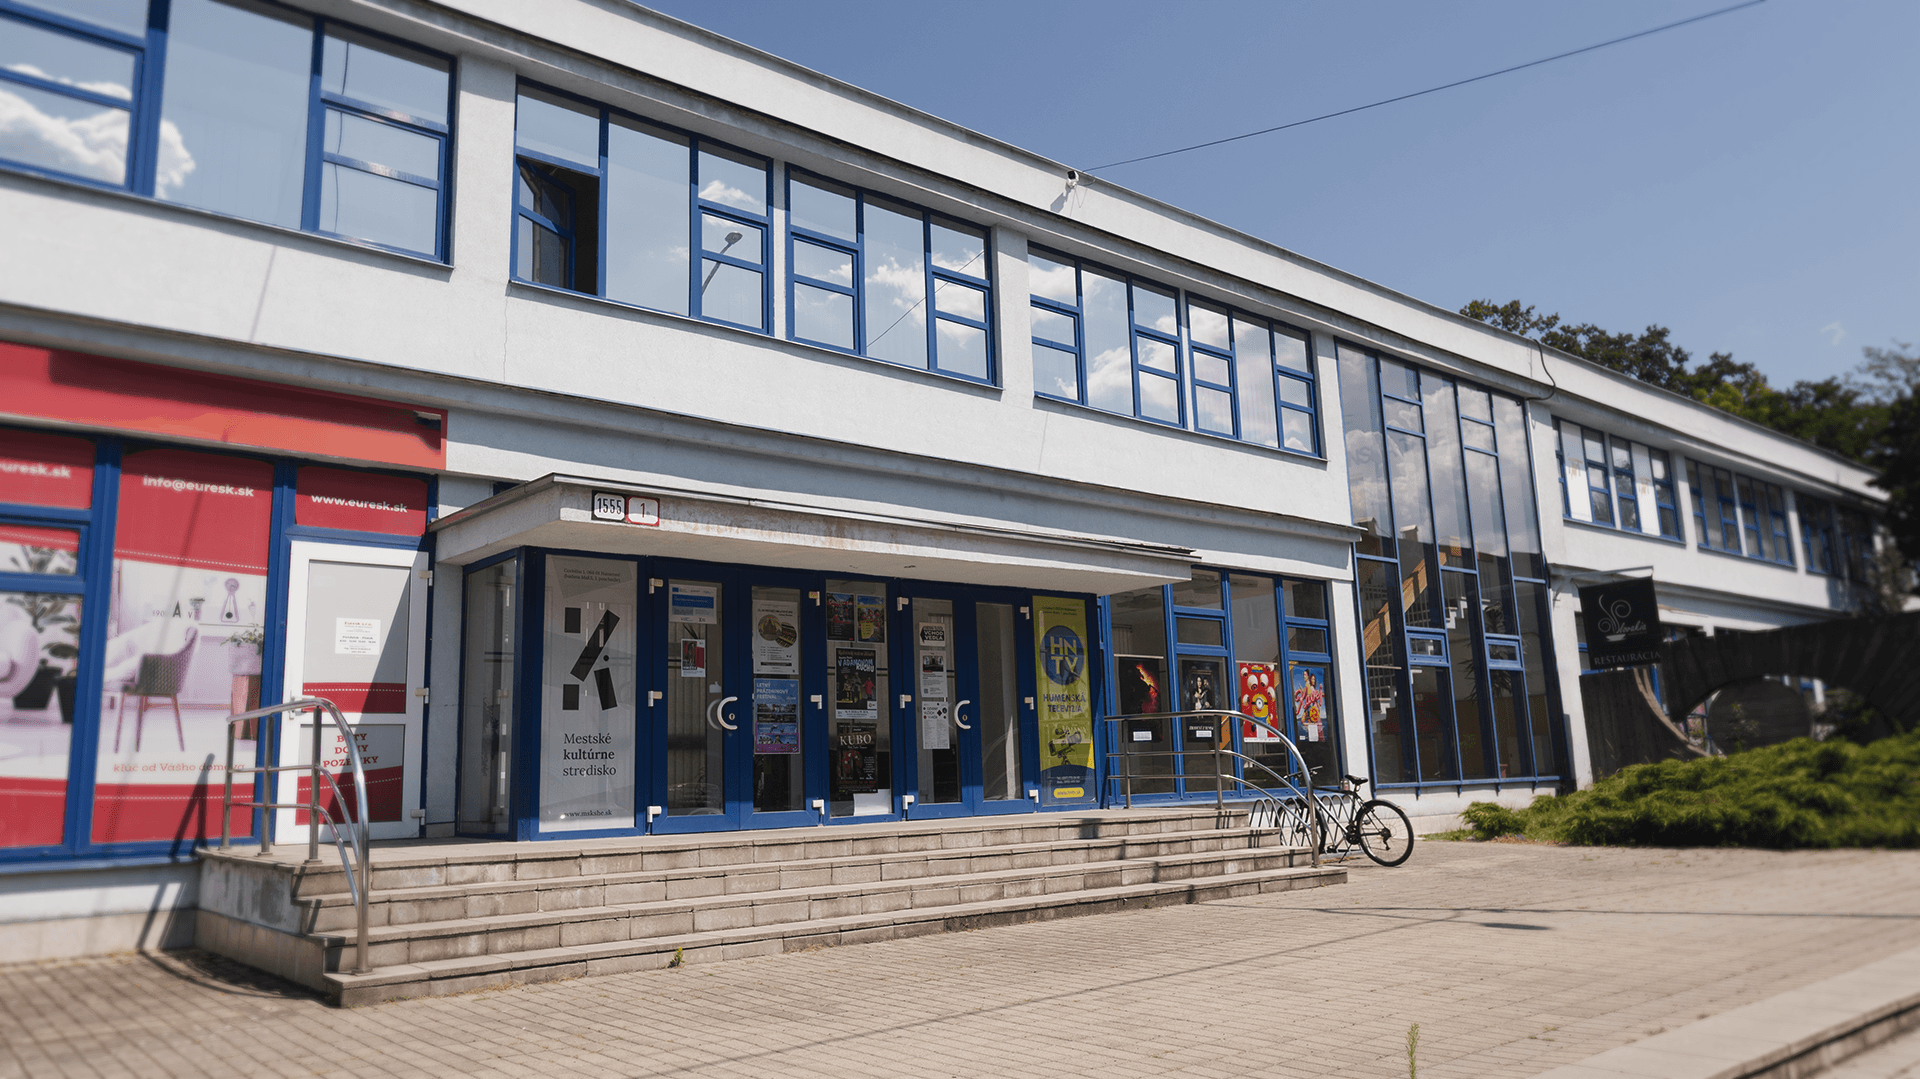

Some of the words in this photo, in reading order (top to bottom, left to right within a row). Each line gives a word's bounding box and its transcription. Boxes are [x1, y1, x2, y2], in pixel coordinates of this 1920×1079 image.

[0, 462, 71, 479] uresk.sk
[143, 475, 254, 497] info@euresk.sk
[311, 494, 408, 513] www.euresk.sk
[597, 498, 622, 514] 1555
[640, 502, 645, 518] 1
[1050, 635, 1077, 656] HN
[1051, 656, 1078, 675] TV
[1043, 692, 1086, 703] HUMENSKÁ
[336, 733, 367, 743] BTY
[563, 732, 612, 745] Mestské
[840, 733, 872, 746] KUBO
[334, 744, 369, 755] DOY
[563, 748, 615, 760] kultúrne
[141, 763, 157, 772] od
[159, 762, 196, 772] Vášho
[323, 755, 379, 768] POZEKY
[562, 764, 617, 777] stredisko
